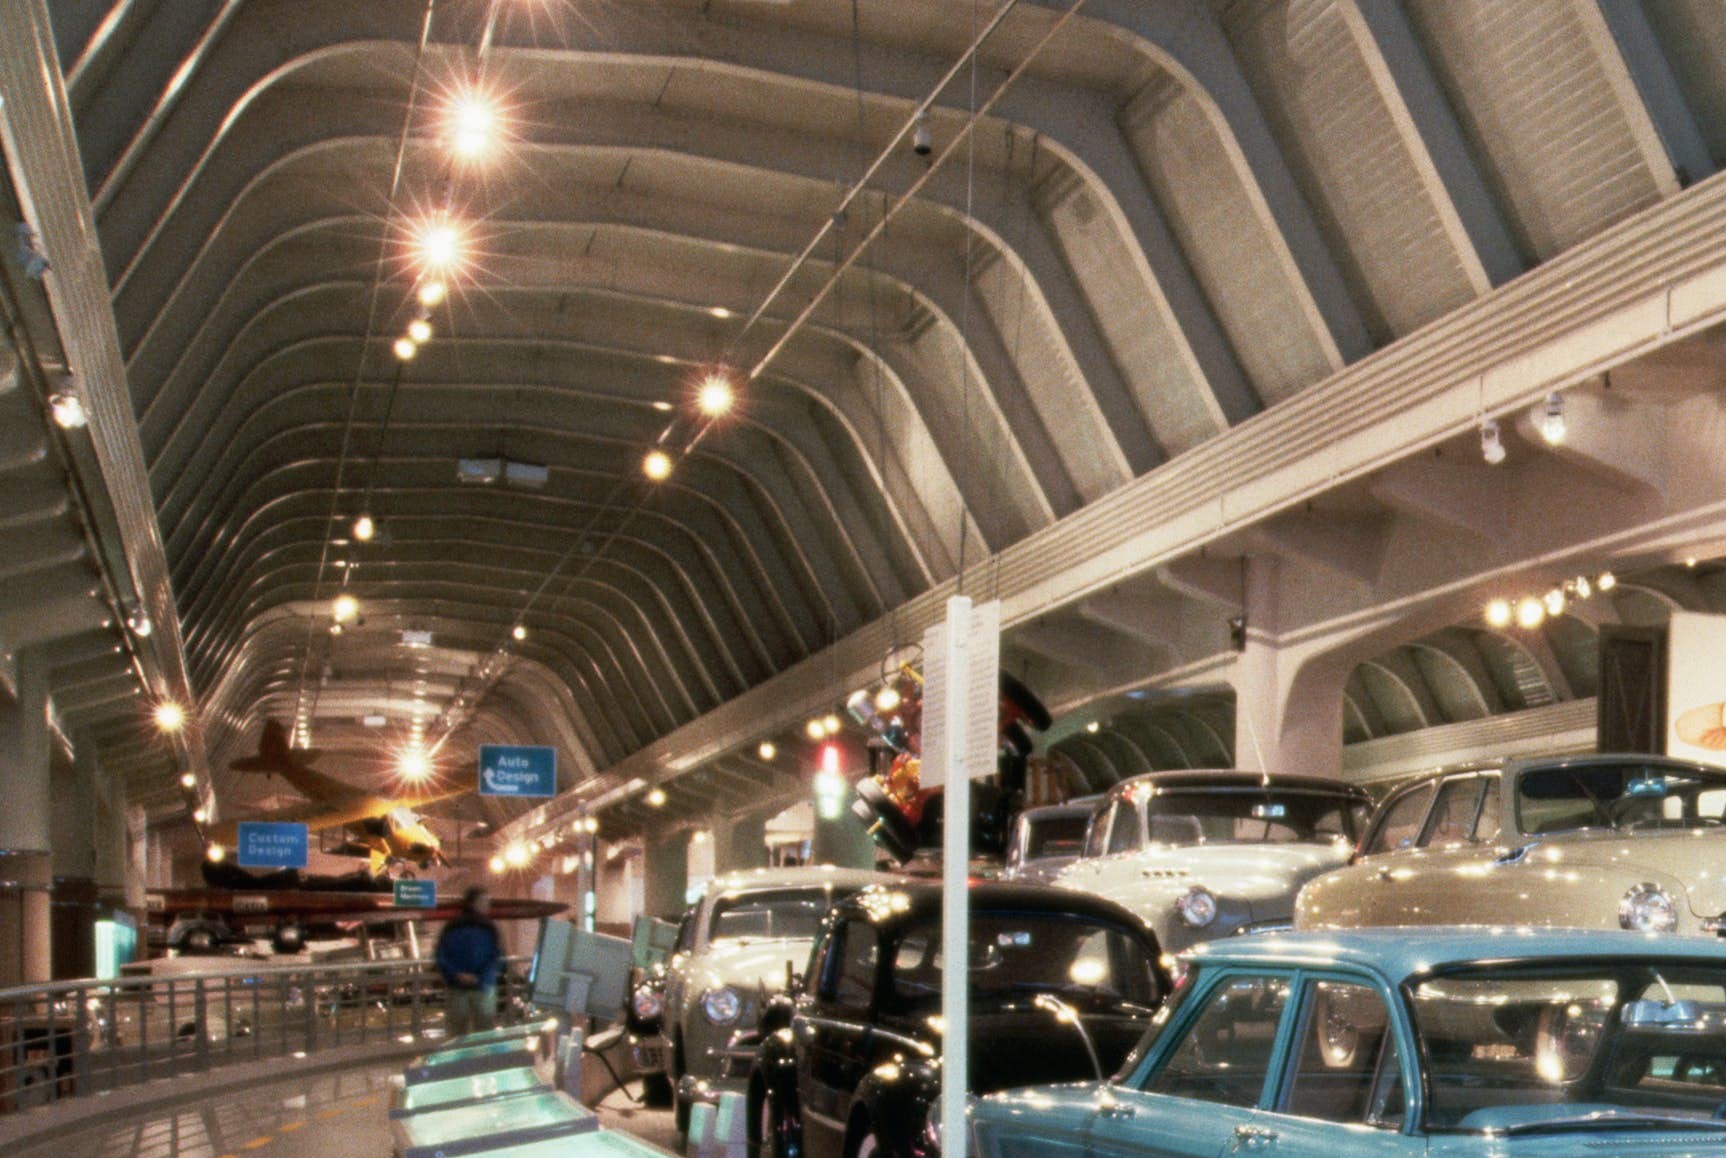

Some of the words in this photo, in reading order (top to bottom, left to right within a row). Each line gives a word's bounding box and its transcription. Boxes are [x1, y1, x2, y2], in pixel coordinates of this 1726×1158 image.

[498, 755, 529, 768] Auto
[496, 770, 540, 785] Design
[248, 832, 299, 844] Custom
[248, 845, 292, 857] Design
